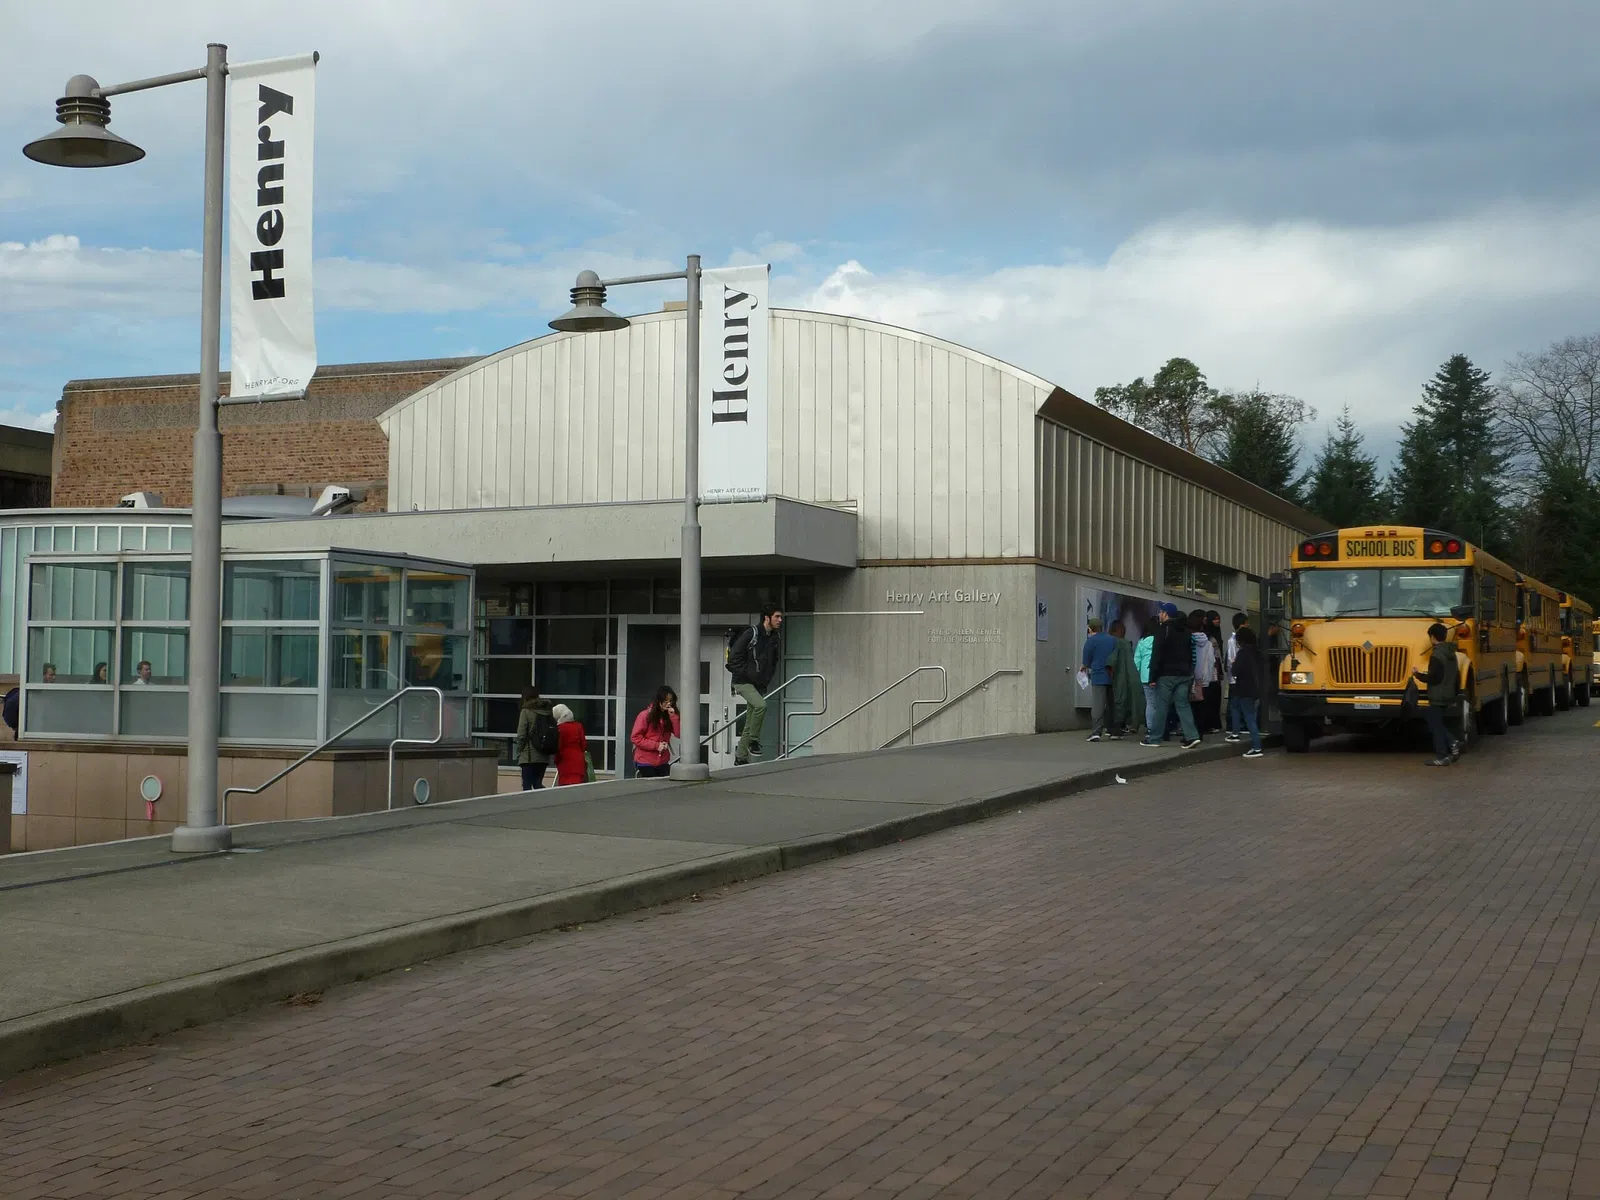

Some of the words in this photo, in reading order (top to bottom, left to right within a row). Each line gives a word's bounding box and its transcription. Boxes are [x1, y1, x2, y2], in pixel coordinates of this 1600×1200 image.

[250, 83, 294, 300] Henry
[712, 283, 758, 427] Henry
[1346, 540, 1390, 557] SCHOOL
[1393, 540, 1415, 557] BUS
[886, 590, 924, 606] Henry
[928, 590, 950, 603] Art
[954, 589, 1002, 606] Gallery
